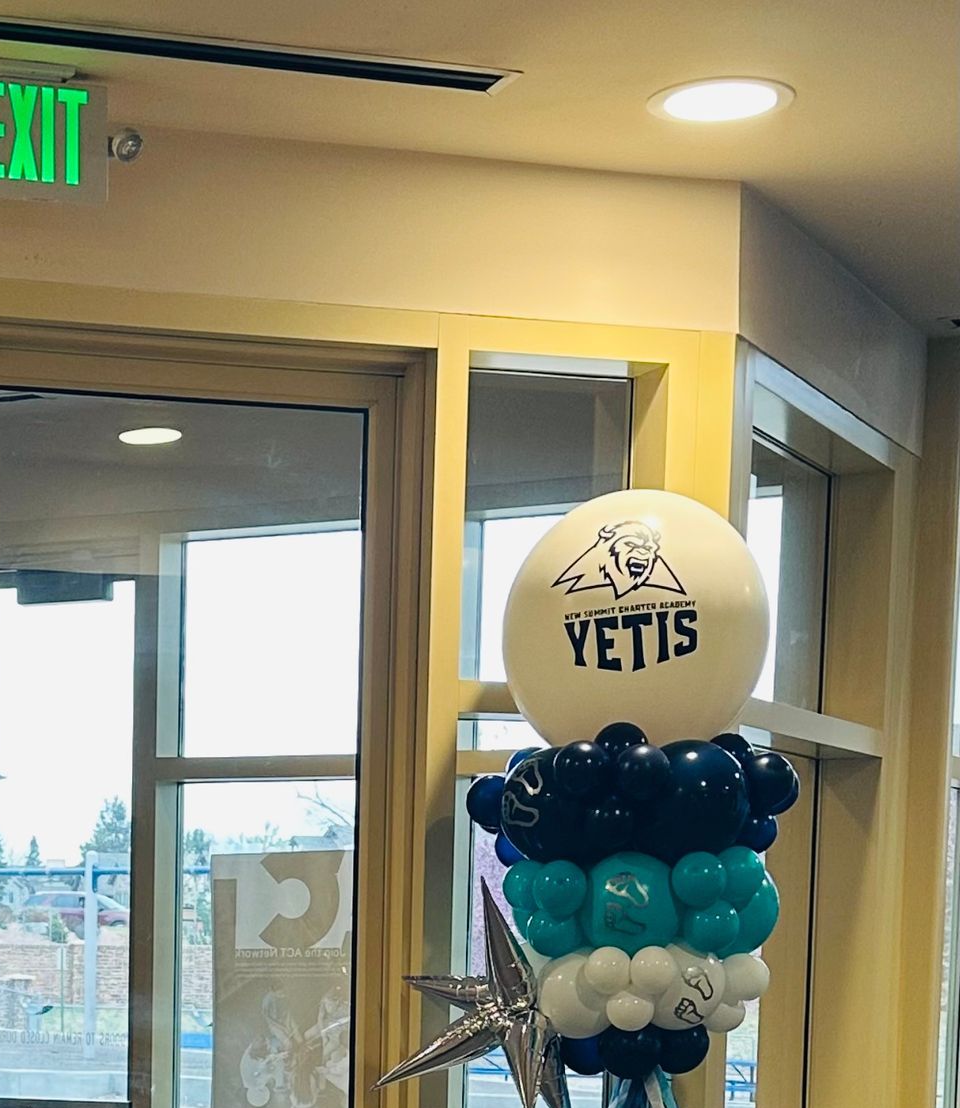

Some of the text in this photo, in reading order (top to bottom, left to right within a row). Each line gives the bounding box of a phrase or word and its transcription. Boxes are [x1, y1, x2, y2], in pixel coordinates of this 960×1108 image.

[564, 600, 697, 621] NEW SUMMIT CHARTER ACADEMY
[563, 609, 698, 672] YETIS
